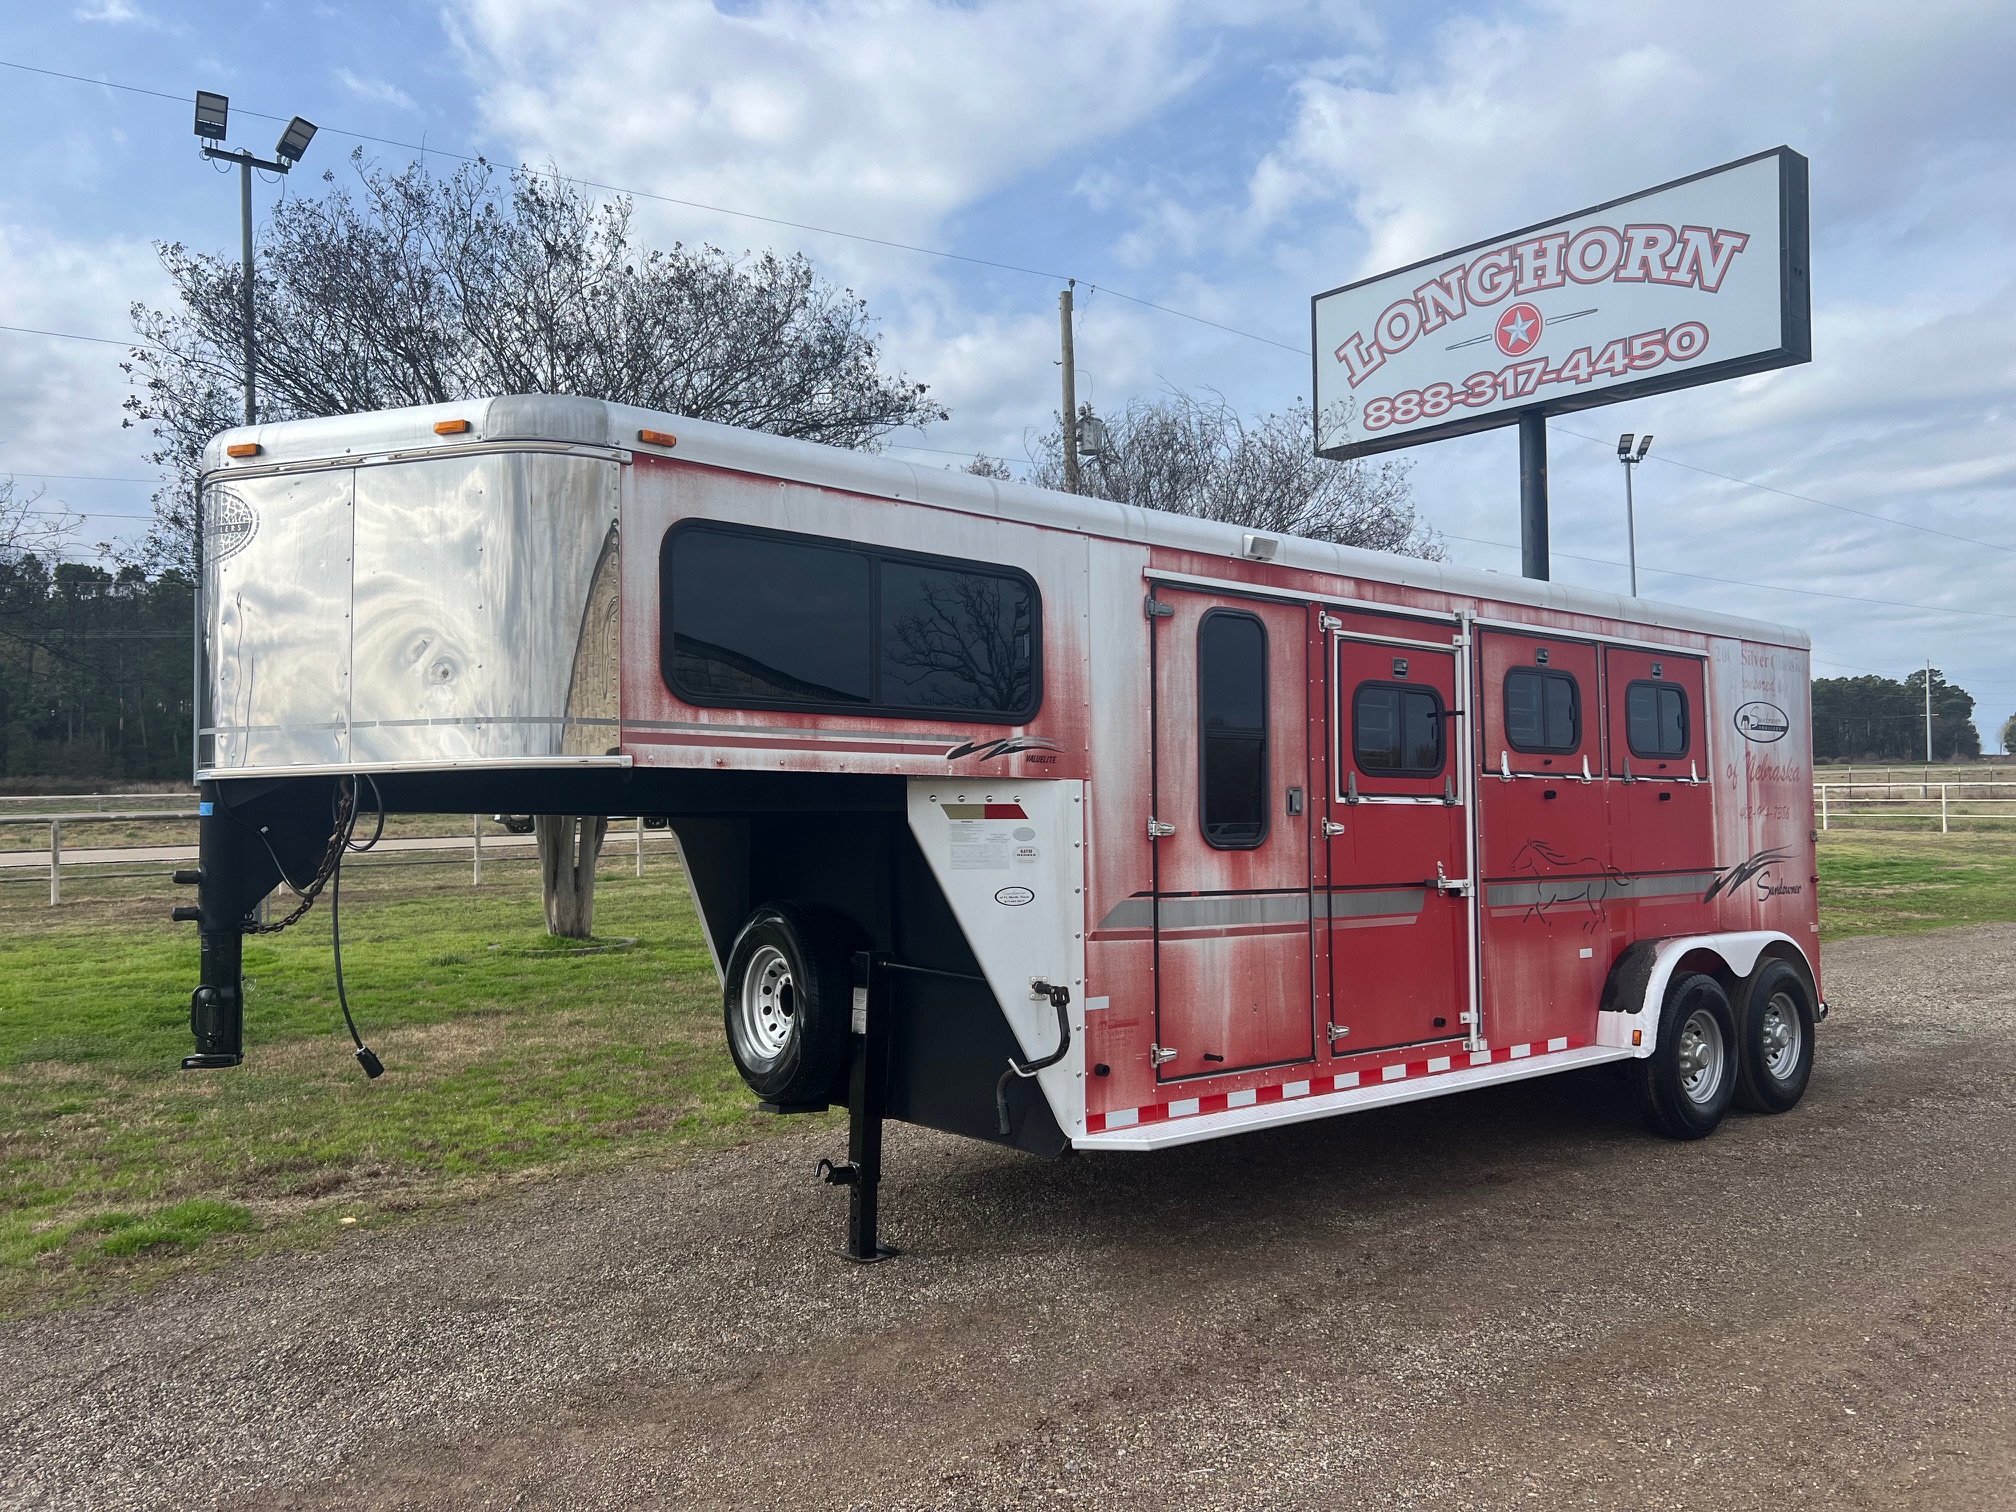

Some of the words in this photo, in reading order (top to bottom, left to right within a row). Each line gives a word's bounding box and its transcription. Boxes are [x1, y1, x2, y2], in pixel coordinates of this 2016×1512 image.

[1335, 223, 1750, 388] LONGHORN
[1363, 321, 1709, 431] 888-317-4450
[1741, 648, 1769, 668] Silver
[1026, 755, 1057, 764] VALUELITE
[1727, 755, 1739, 790] of
[1746, 751, 1801, 782] Nebraska
[1757, 870, 1802, 902] Sundowner
